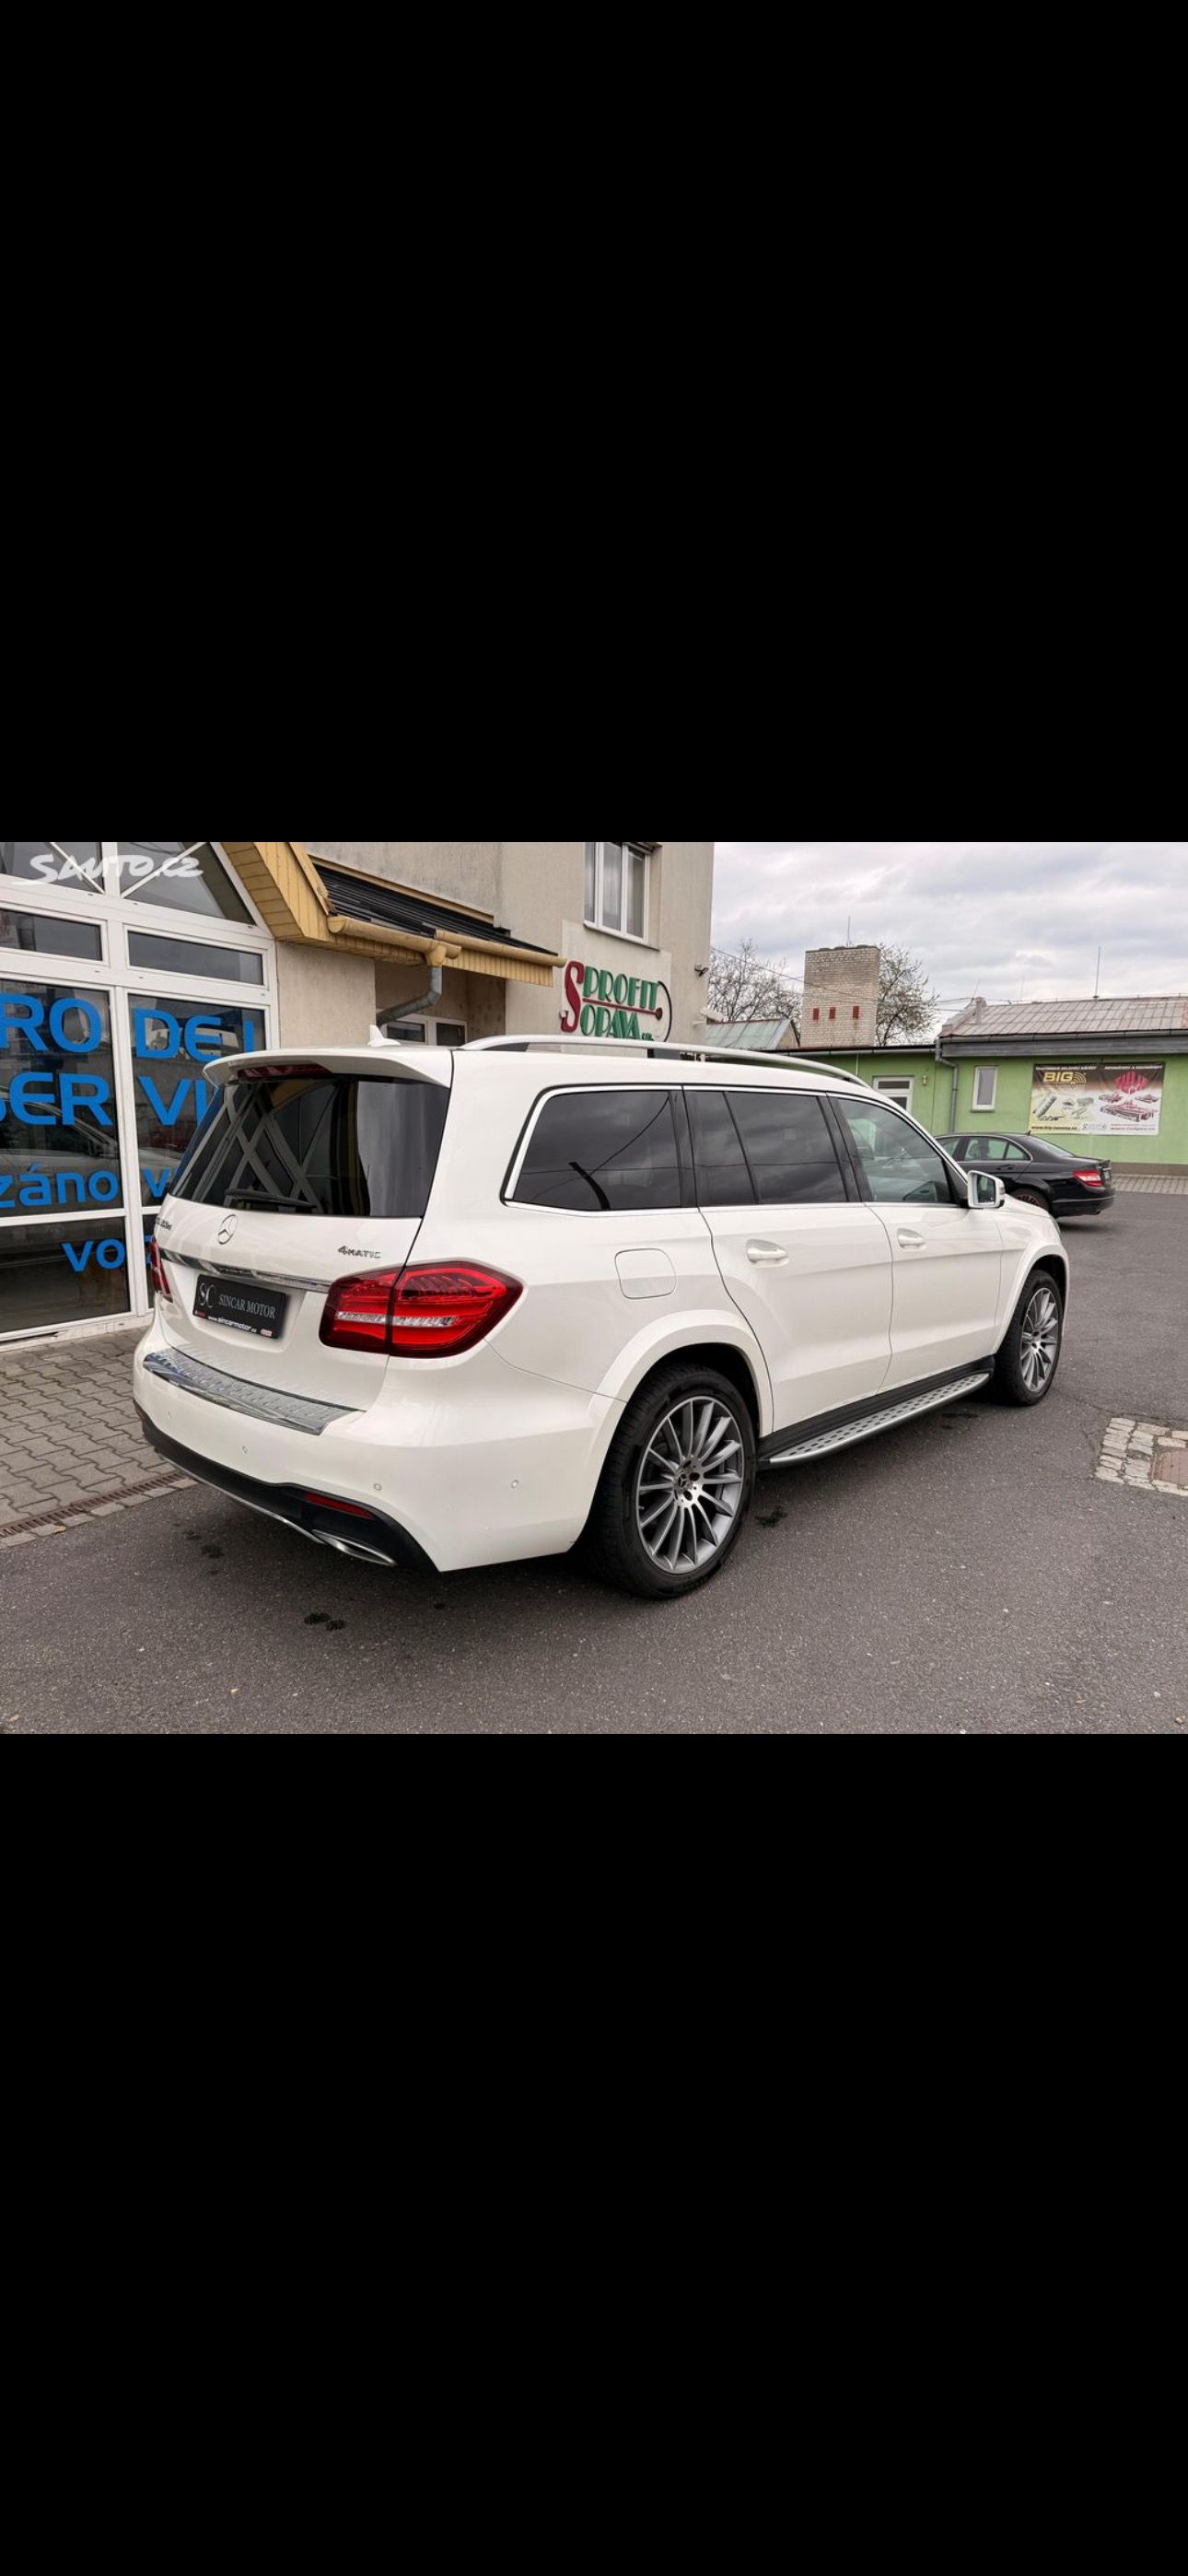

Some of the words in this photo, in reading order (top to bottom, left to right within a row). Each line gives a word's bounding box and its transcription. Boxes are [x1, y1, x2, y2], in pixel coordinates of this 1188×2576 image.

[1042, 1071, 1074, 1083] BIG
[0, 1071, 113, 1126] ER
[218, 1294, 245, 1311] SINCAR
[245, 1300, 276, 1319] MOTOR
